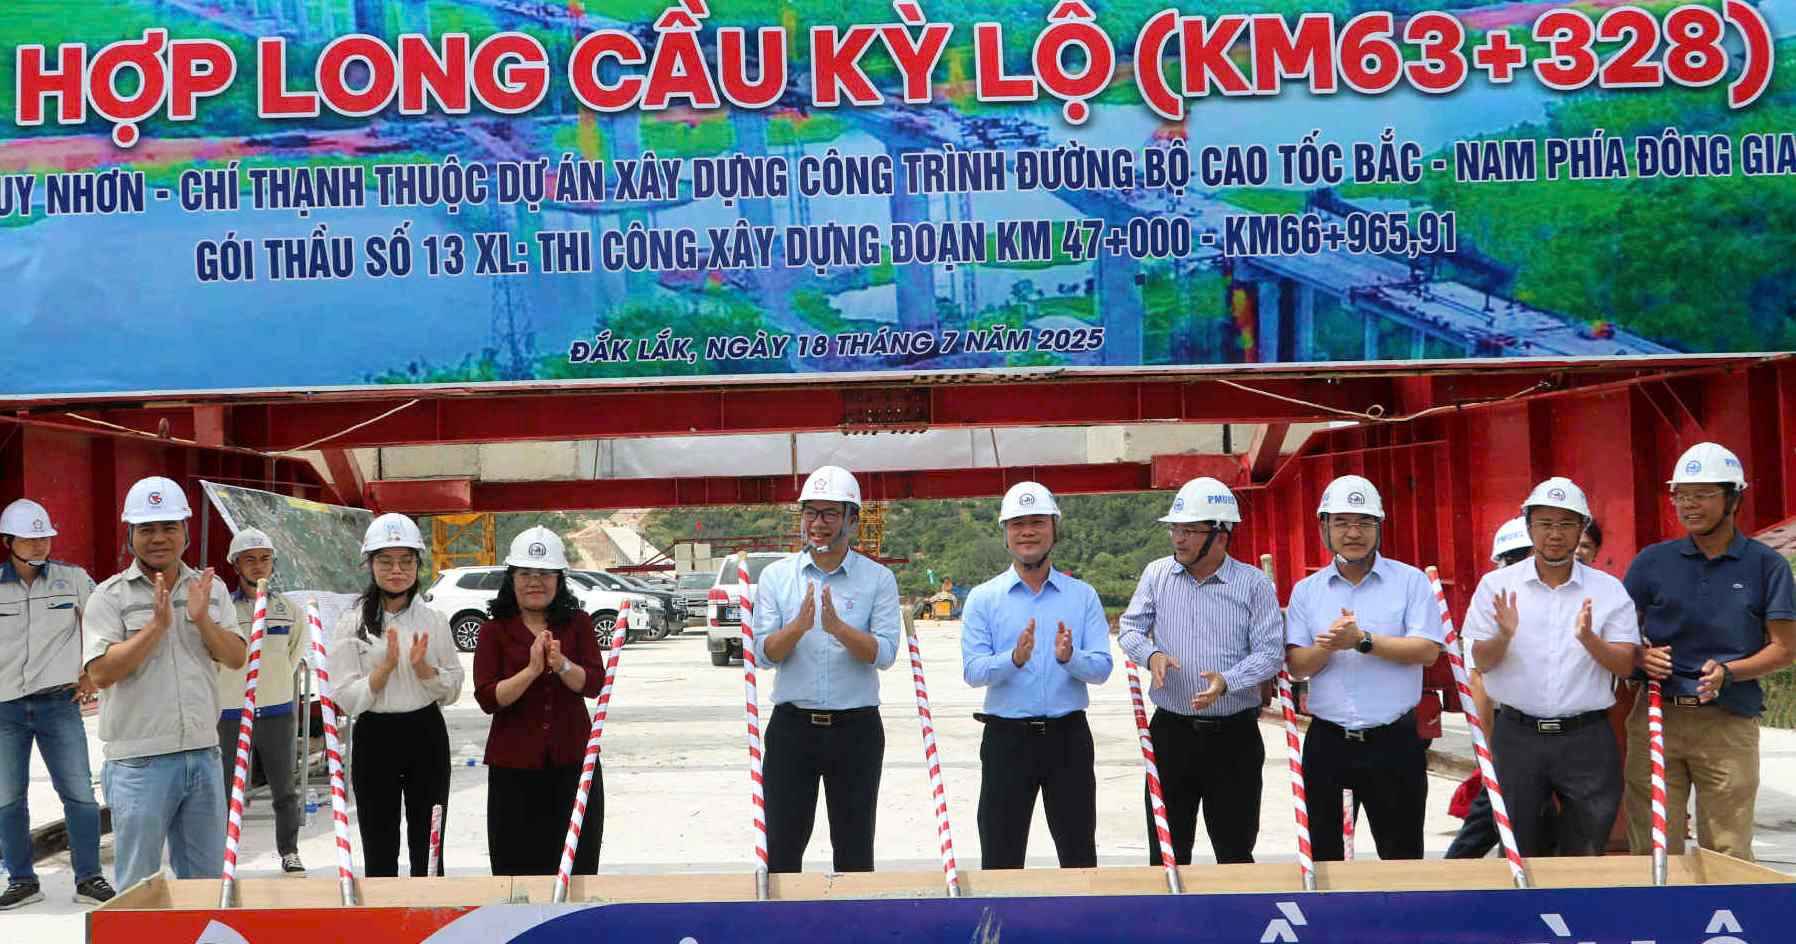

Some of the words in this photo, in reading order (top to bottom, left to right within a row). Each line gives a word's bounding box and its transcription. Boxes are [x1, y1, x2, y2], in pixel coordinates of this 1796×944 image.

[16, 28, 237, 148] HỢP
[257, 32, 549, 118] LONG
[568, 0, 787, 111] CẦU
[811, 0, 953, 107] KỲ
[974, 0, 1115, 125] LỘ
[1134, 0, 1774, 120] (KM63+328)
[45, 168, 145, 215] NHƠN
[155, 188, 171, 199] -
[179, 160, 239, 212] CHÍ
[248, 163, 365, 217] THẠNH
[373, 155, 488, 214] THUỘC
[497, 157, 548, 212] DỰ
[555, 151, 604, 203] ÁN
[614, 152, 681, 201] XÂY
[691, 152, 789, 207] DỰNG
[798, 147, 894, 197] CÔNG
[901, 143, 1007, 194] TRÌNH
[1015, 142, 1135, 191] ĐƯỜNG
[1143, 138, 1190, 197] BỘ
[1199, 144, 1268, 187] CAO
[1277, 128, 1343, 186] TỐC
[1353, 127, 1423, 184] BẮC
[1431, 158, 1446, 170] -
[1455, 139, 1537, 182] NAM
[1545, 130, 1626, 179] PHÍA
[1636, 127, 1732, 178] ĐÔNG
[1741, 133, 1796, 176] GIA
[195, 231, 254, 282] GÓI
[263, 223, 355, 281] THẦU
[364, 221, 413, 278] SỐ
[422, 233, 464, 276] 13
[474, 230, 528, 275] XL:
[536, 229, 592, 273] THI
[602, 222, 697, 272] CÔNG
[706, 217, 774, 269] XÂY
[785, 220, 881, 276] DỰNG
[889, 220, 990, 273] ĐOẠN
[996, 218, 1052, 264] KM
[1060, 215, 1191, 262] 47+000
[1200, 232, 1215, 245] -
[1223, 211, 1458, 259] KM66+965,91
[568, 329, 630, 364] ĐẮK
[636, 328, 697, 364] LẮK,
[703, 325, 790, 360] NGÀY
[795, 333, 828, 358] 18
[834, 325, 934, 356] THÁNG
[940, 329, 958, 354] 7
[962, 324, 1033, 353] NĂM
[1036, 326, 1105, 352] 2025
